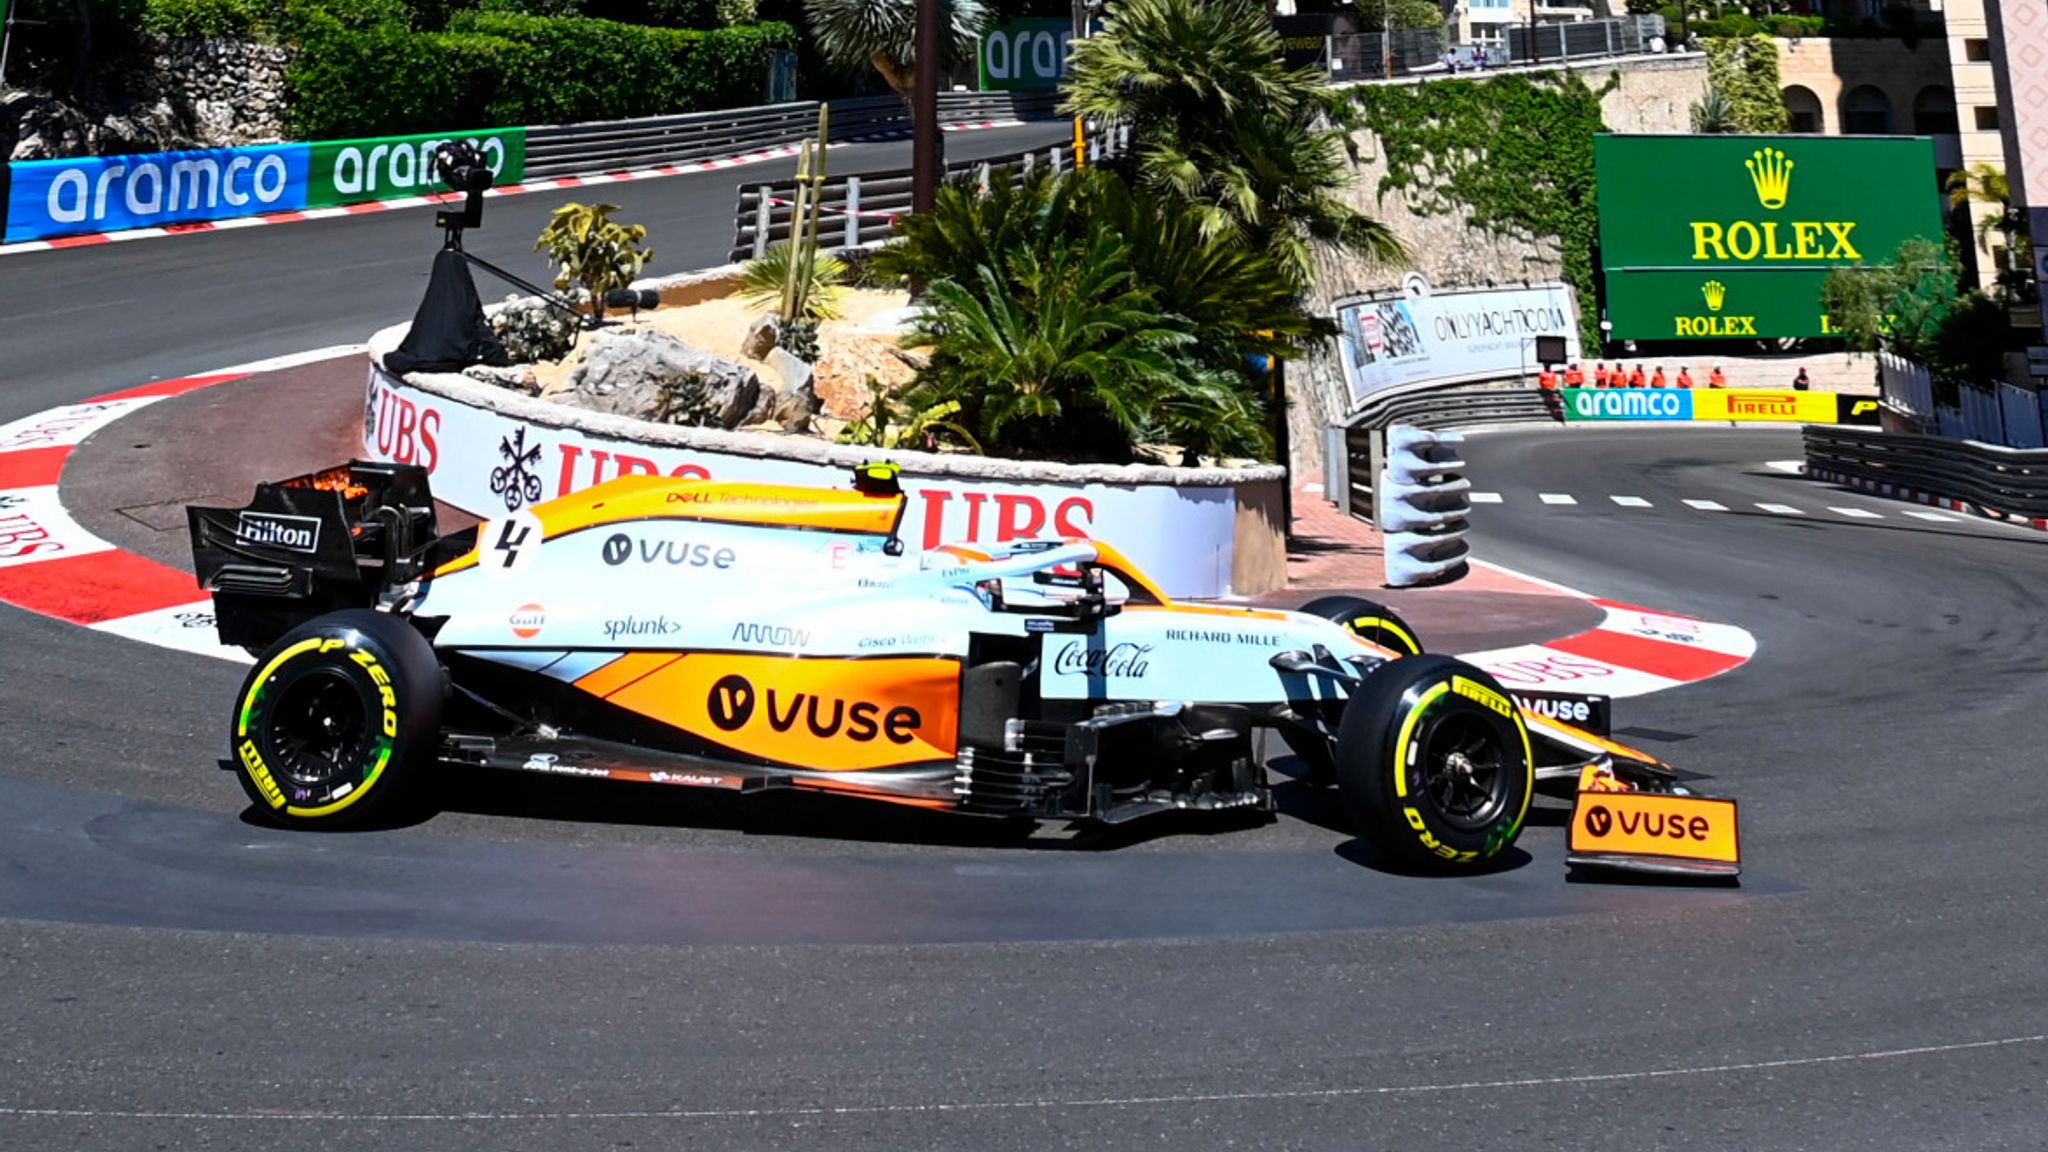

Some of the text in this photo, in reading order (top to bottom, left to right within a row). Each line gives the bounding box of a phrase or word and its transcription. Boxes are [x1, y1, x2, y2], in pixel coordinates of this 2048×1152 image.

[47, 153, 288, 223] aramco
[1690, 220, 1862, 260] ROLEX
[1675, 316, 1757, 336] ROLEX
[1576, 391, 1680, 416] aramco
[1727, 394, 1796, 415] PIRELLI
[376, 388, 441, 475] UBS
[494, 519, 531, 568] 4
[639, 538, 736, 570] vuse
[603, 614, 682, 641] splunk>
[1166, 628, 1281, 647] RICHARD MILLE
[318, 637, 398, 738] P ZERO
[766, 688, 922, 745] vuse
[1526, 696, 1590, 722] vuse
[671, 773, 723, 785] KAUST
[1403, 806, 1480, 863] ZERO
[1617, 809, 1710, 841] vuse
